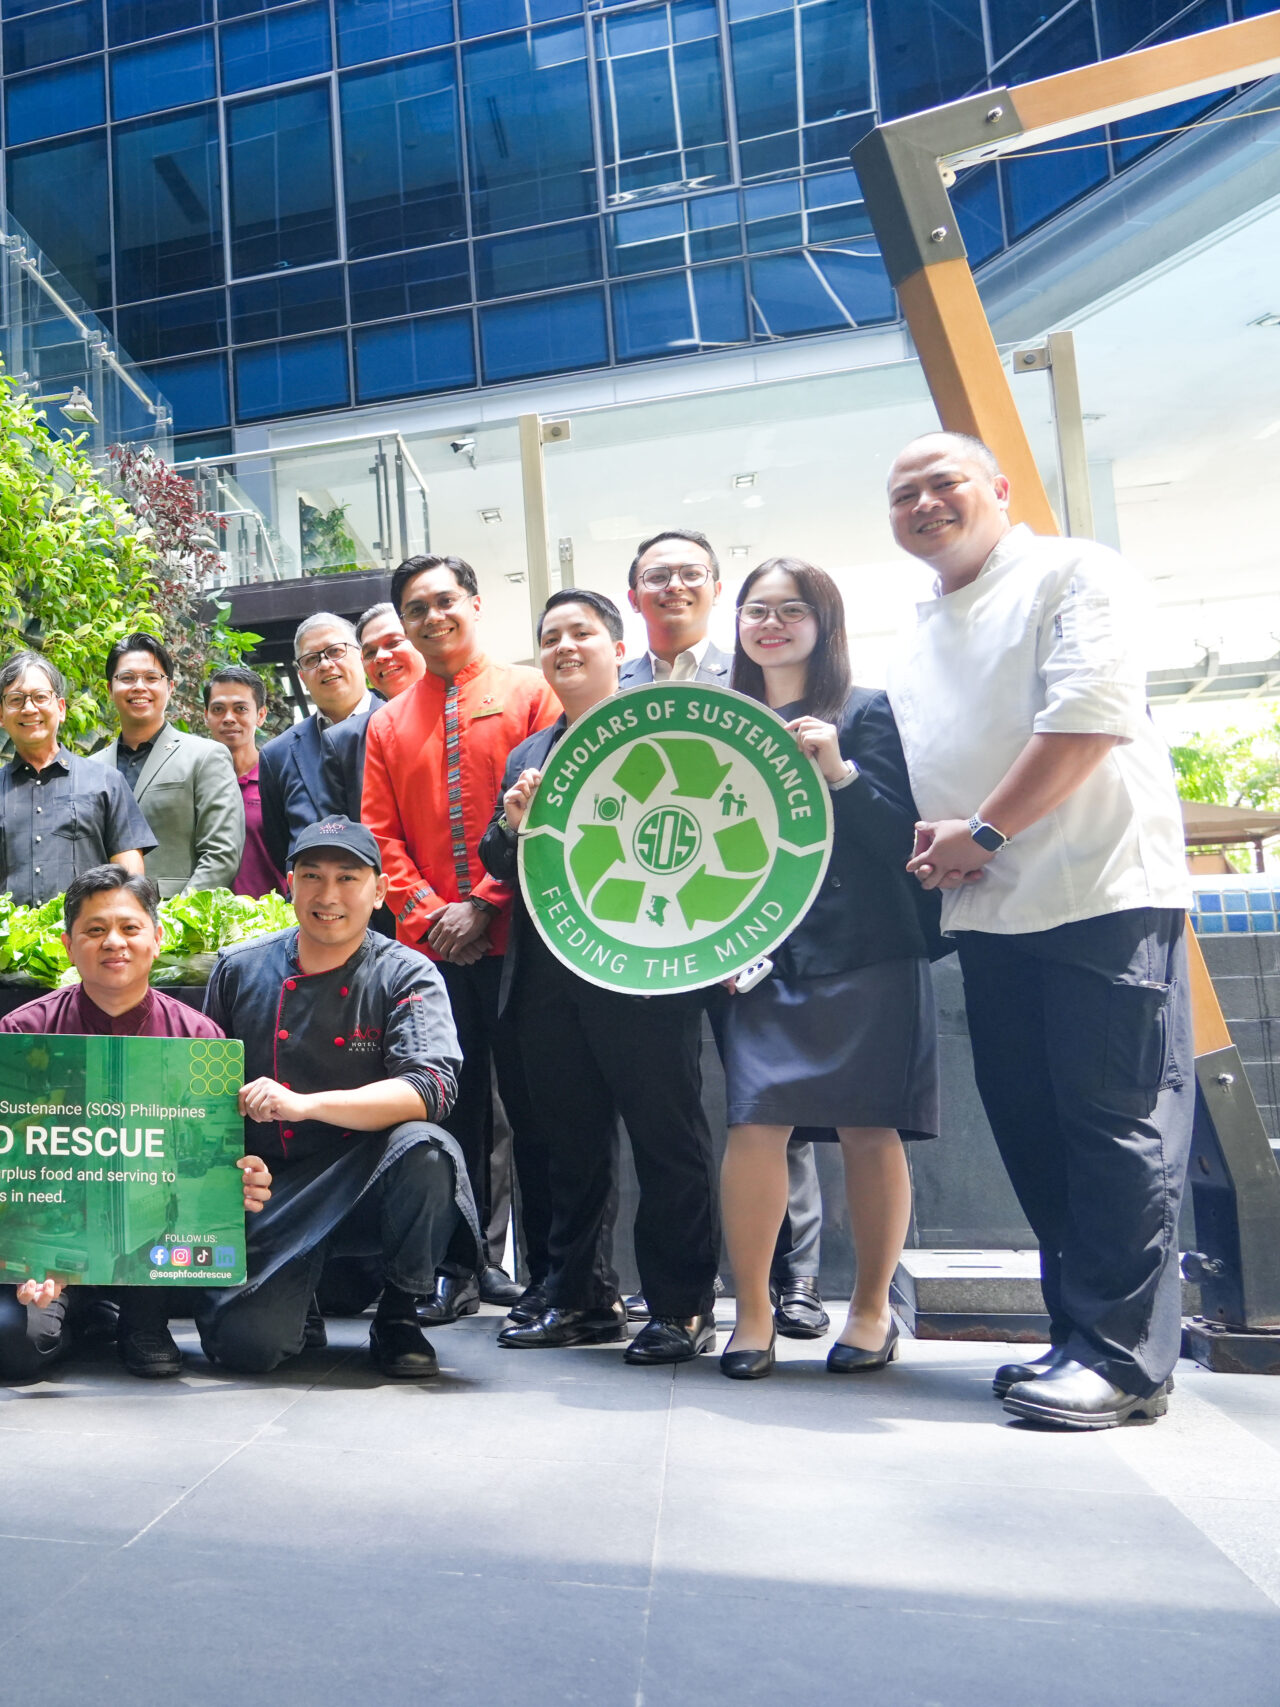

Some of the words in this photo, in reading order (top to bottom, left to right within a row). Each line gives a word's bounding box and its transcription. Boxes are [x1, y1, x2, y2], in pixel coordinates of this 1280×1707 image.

[546, 708, 638, 807] SCHOLARS
[646, 700, 676, 721] OF
[686, 700, 812, 821] SUSTENANCE
[637, 810, 698, 870] SOS
[541, 885, 628, 974] FEEDING
[644, 953, 699, 979] THE
[713, 900, 784, 963] MIND
[348, 1024, 382, 1041] SAVO
[0, 1101, 82, 1115] Sustenance
[86, 1102, 126, 1119] (SOS)
[130, 1104, 206, 1120] Philippines
[26, 1126, 165, 1158] RESCUE
[41, 1166, 73, 1180] food
[77, 1168, 103, 1181] and
[107, 1169, 158, 1186] serving
[161, 1171, 176, 1183] to
[11, 1189, 24, 1202] in
[28, 1190, 66, 1203] need.
[165, 1233, 202, 1243] FOLLOW
[203, 1234, 218, 1243] US:
[149, 1269, 232, 1280] @sosphfoodrescue
